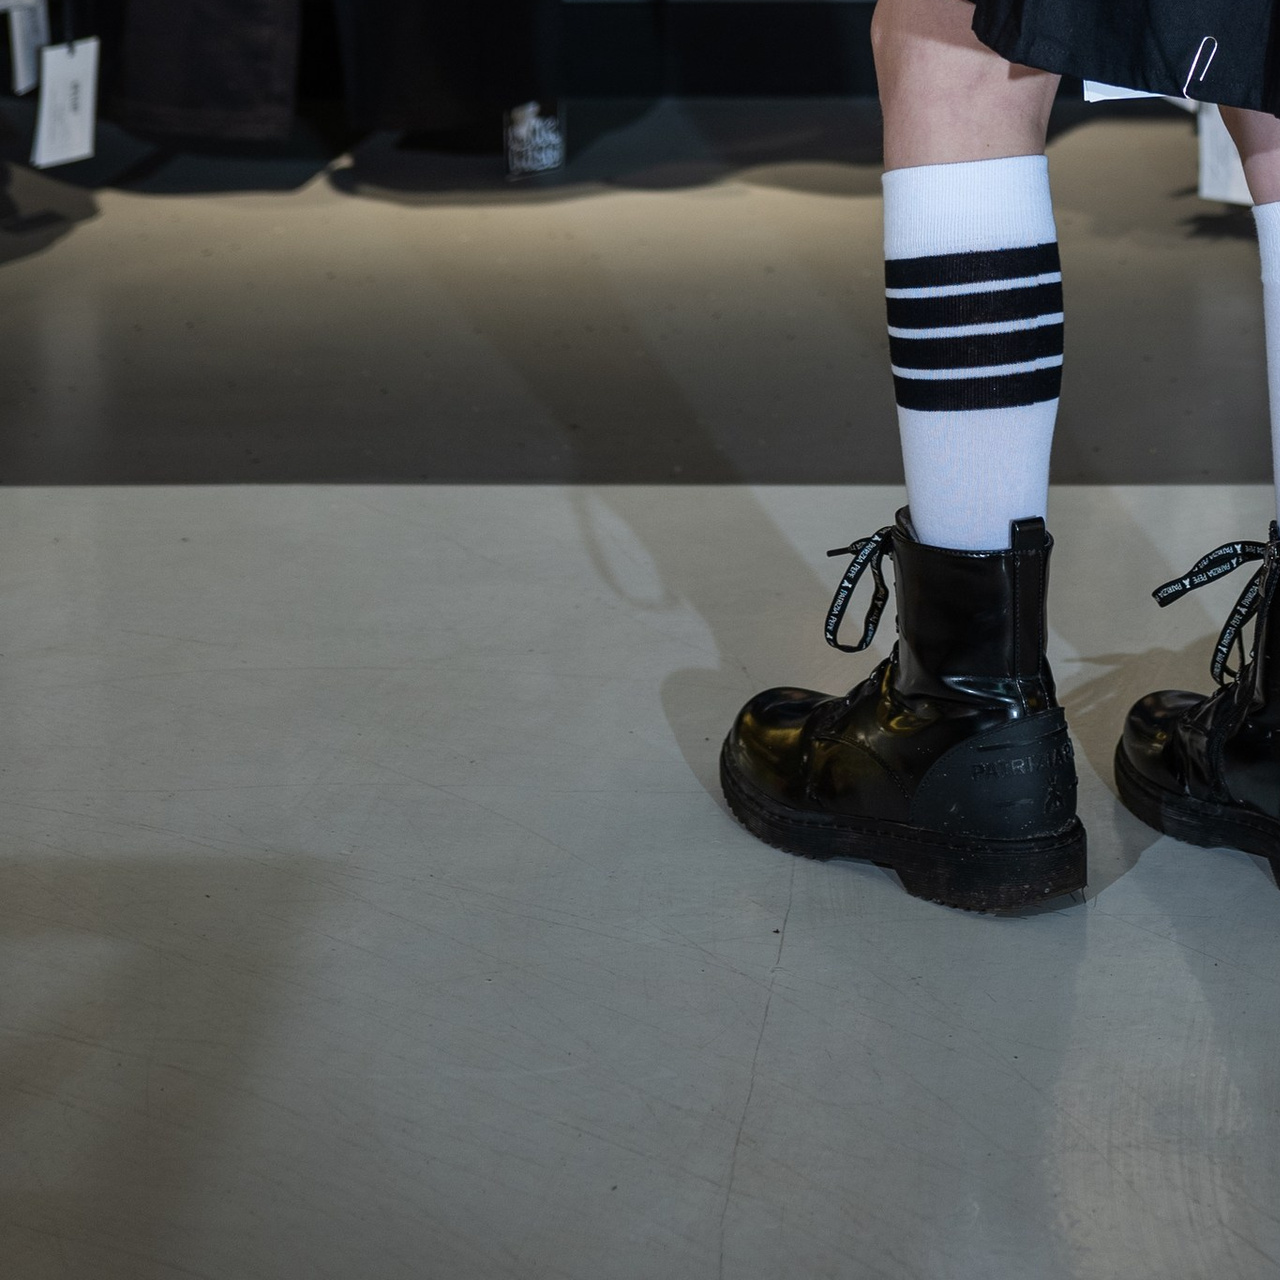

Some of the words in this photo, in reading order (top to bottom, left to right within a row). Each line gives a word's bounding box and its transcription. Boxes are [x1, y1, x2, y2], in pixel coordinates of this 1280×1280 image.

[856, 541, 876, 563] PATRIZIA
[847, 564, 861, 579] PEPE
[1207, 562, 1231, 577] PATRIZIA
[1192, 573, 1208, 584] PEPE
[1158, 582, 1182, 598] PATRIZIA
[1241, 585, 1259, 607] PATRIZIA
[832, 588, 848, 615] PATRIZIA
[827, 615, 838, 631] PEPE
[1230, 614, 1243, 627] PEPE
